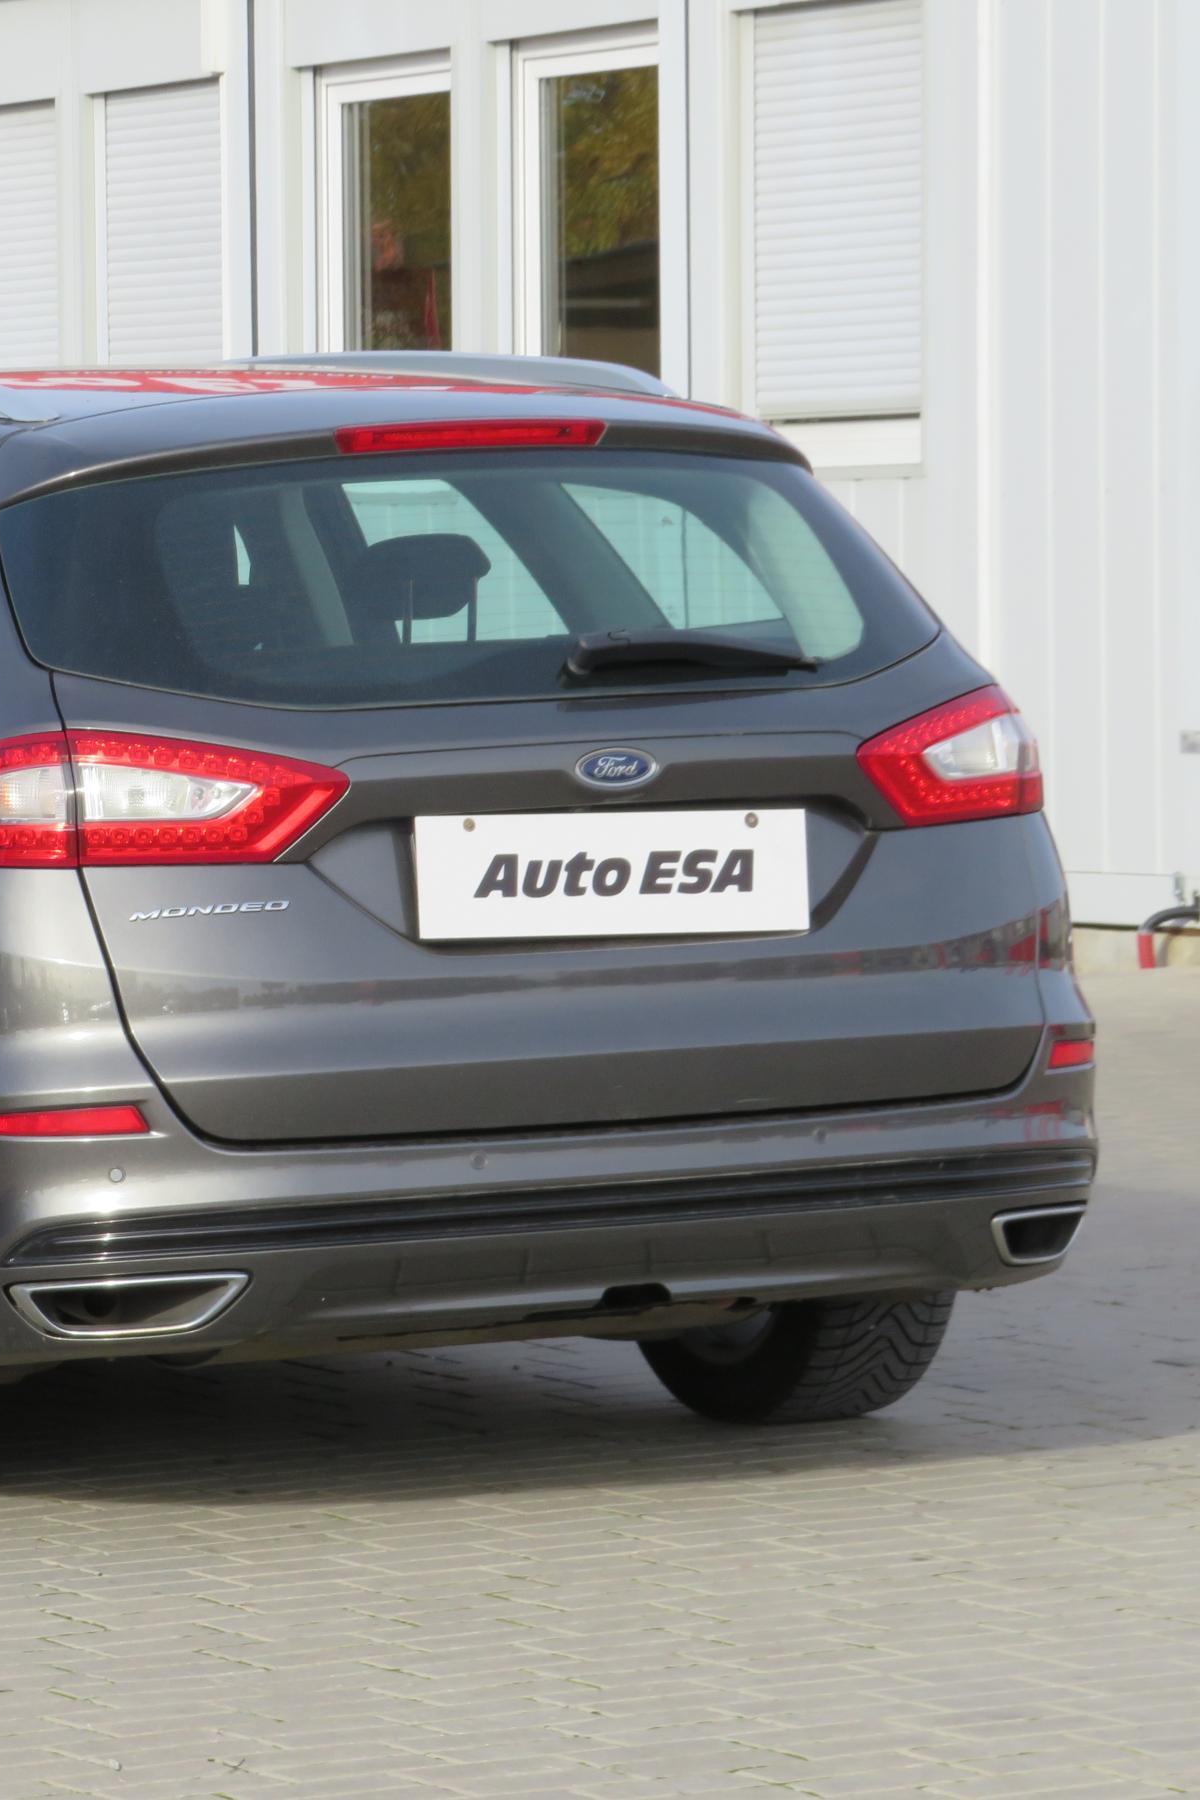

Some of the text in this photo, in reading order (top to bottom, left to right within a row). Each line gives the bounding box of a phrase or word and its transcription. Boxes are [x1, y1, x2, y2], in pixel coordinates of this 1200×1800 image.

[594, 756, 639, 777] Ford
[474, 849, 754, 898] Auto ESA
[129, 900, 290, 921] MONDEO
